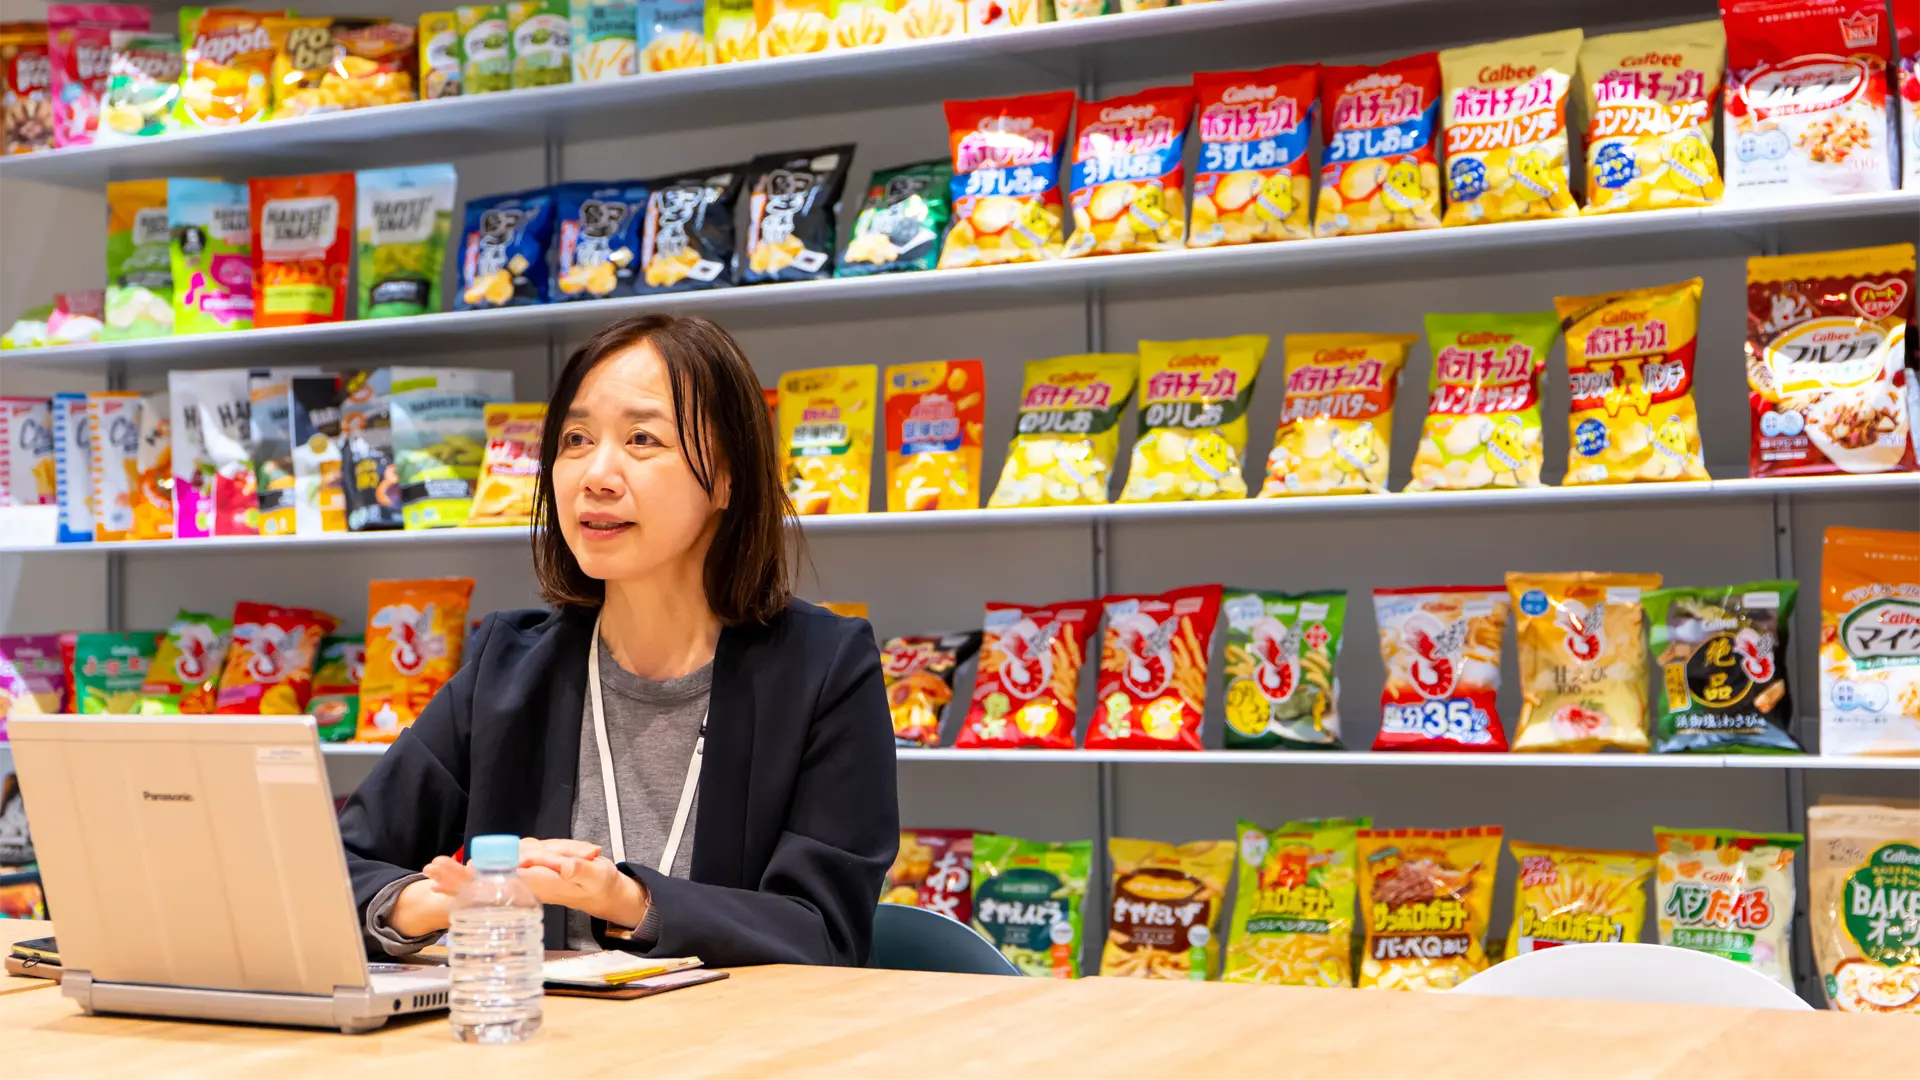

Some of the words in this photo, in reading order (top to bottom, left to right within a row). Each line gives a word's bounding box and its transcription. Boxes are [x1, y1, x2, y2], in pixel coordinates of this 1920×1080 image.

[1478, 64, 1537, 84] Calbee
[1621, 53, 1682, 68] Calbee
[1223, 85, 1276, 103] Calbee
[1454, 76, 1553, 118] ポテトチップス
[1594, 70, 1705, 102] ポテトチップス
[1201, 97, 1296, 141] ポテトチップス
[1448, 109, 1556, 150] コンソメパンチ
[1584, 320, 1667, 356] ポテトチップス
[1786, 338, 1879, 364] フルグラ
[1812, 331, 1850, 343] Calbee
[1287, 358, 1385, 393] ポテトチップス
[1436, 343, 1533, 381] ポテトチップス
[1023, 381, 1112, 410] ポテトチップス
[1148, 368, 1238, 401] ポテトチップス
[1018, 410, 1094, 432] のりしお
[1145, 401, 1224, 428] のりしお
[142, 790, 193, 802] Panasonic
[1373, 898, 1469, 933] サッポロポテト
[1666, 883, 1772, 927] ベジたべる
